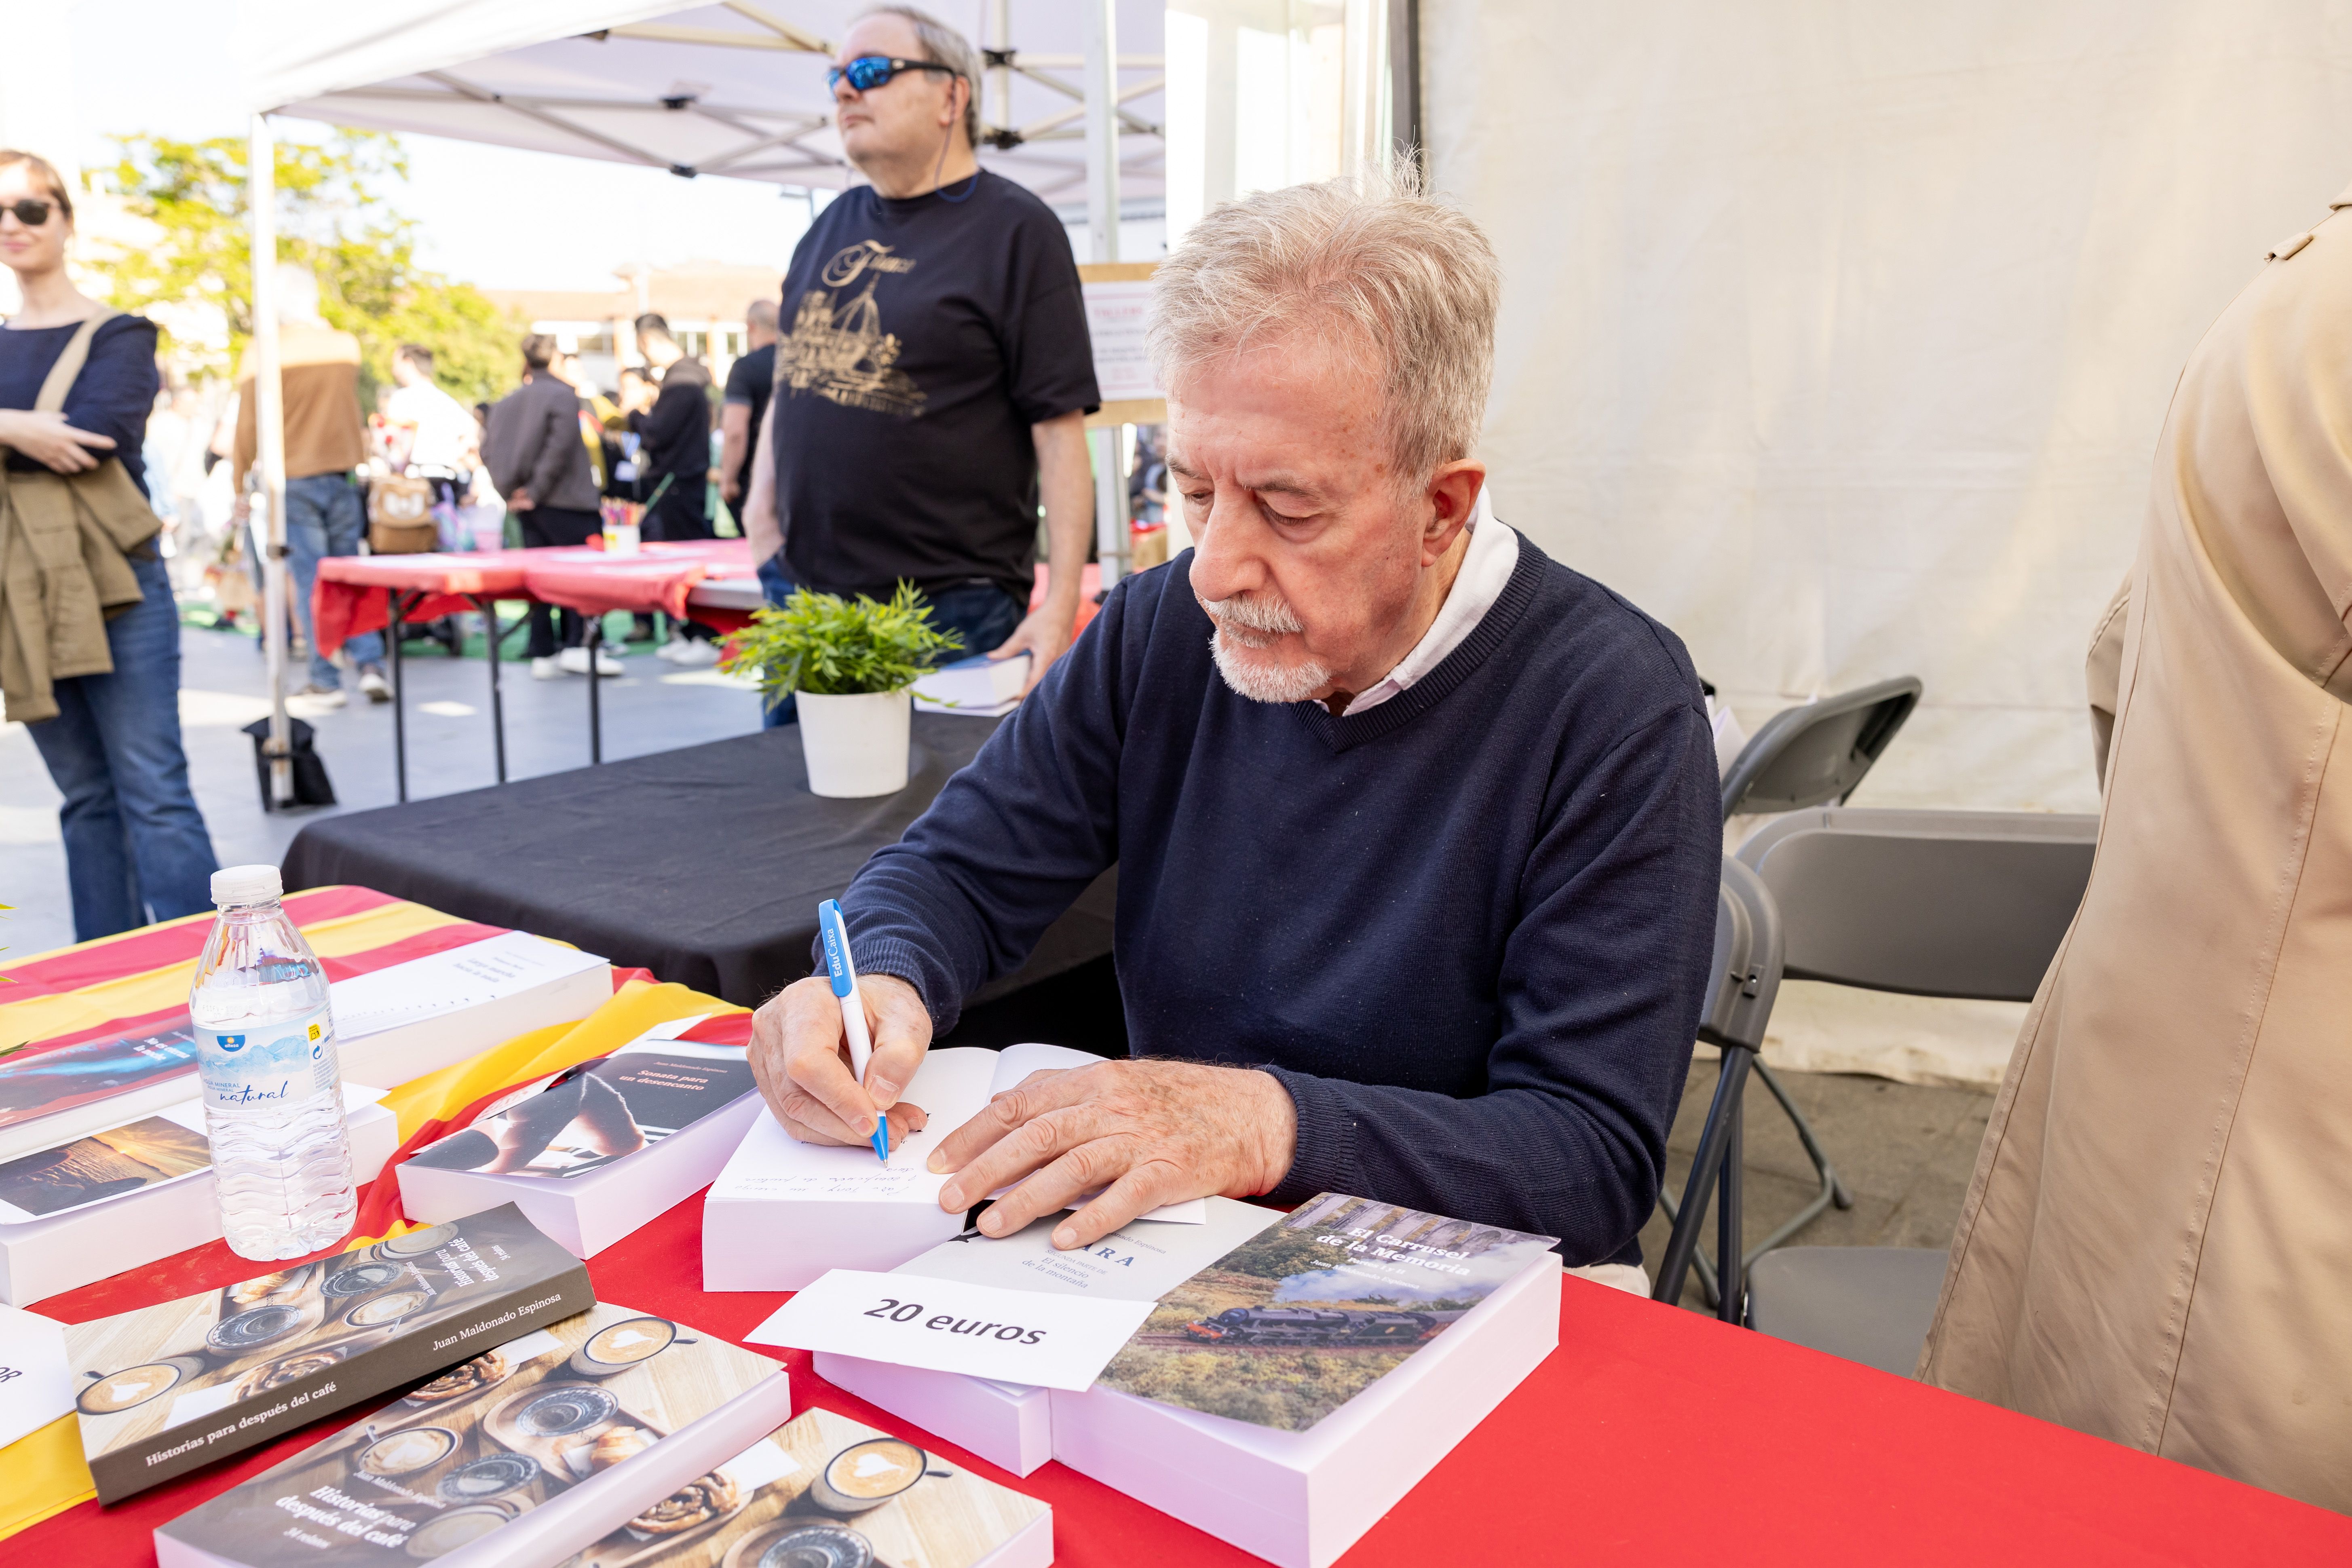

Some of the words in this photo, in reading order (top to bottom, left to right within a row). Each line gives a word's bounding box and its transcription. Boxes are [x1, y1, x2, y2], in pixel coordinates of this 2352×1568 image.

[828, 928, 842, 977] EduCaixa
[637, 1070, 678, 1080] Sonata
[677, 1075, 709, 1083] para
[637, 1078, 705, 1090] desencanto
[220, 1080, 289, 1105] natural
[448, 1238, 471, 1252] café
[492, 1245, 507, 1257] relatos
[1111, 1232, 1134, 1242] onado
[1134, 1239, 1166, 1254] Espinosa
[1347, 1227, 1375, 1239] El
[1376, 1234, 1470, 1260] Carrusel
[435, 1249, 457, 1262] para
[458, 1250, 479, 1262] del
[1045, 1249, 1076, 1264] SEGUNDA
[1076, 1261, 1097, 1271] PARTE
[1316, 1235, 1344, 1246] de
[1345, 1241, 1368, 1253] la
[1370, 1247, 1471, 1276] Memoria
[1347, 1257, 1379, 1270] Partes
[406, 1261, 420, 1276] Espinosa
[444, 1261, 475, 1287] Historias
[469, 1260, 500, 1281] después
[1022, 1258, 1035, 1267] de
[1035, 1264, 1046, 1272] la
[1045, 1270, 1088, 1288] montaña
[1041, 1257, 1054, 1265] El
[1053, 1261, 1089, 1278] silencio
[1310, 1259, 1332, 1268] Juan
[1332, 1264, 1381, 1280] Maldonado
[1381, 1276, 1420, 1289] Espinosa
[414, 1272, 431, 1291] Maldonado
[426, 1287, 437, 1296] Juan
[433, 1336, 458, 1351] Juan
[459, 1312, 516, 1340] Maldonado
[517, 1294, 561, 1316] Espinosa
[863, 1298, 924, 1322] 20
[925, 1316, 1047, 1344] euros
[145, 1437, 205, 1467] Historias
[206, 1424, 236, 1444] para
[239, 1403, 288, 1429] después
[290, 1392, 310, 1408] del
[312, 1381, 337, 1399] café
[353, 1470, 374, 1482] Juan
[372, 1477, 414, 1496] Maldonado
[411, 1492, 446, 1509] Espinosa
[309, 1485, 385, 1520] Historias
[372, 1514, 417, 1531] para
[275, 1495, 342, 1527] después
[336, 1519, 373, 1536] del
[364, 1530, 409, 1548] café
[296, 1532, 331, 1549] relatos
